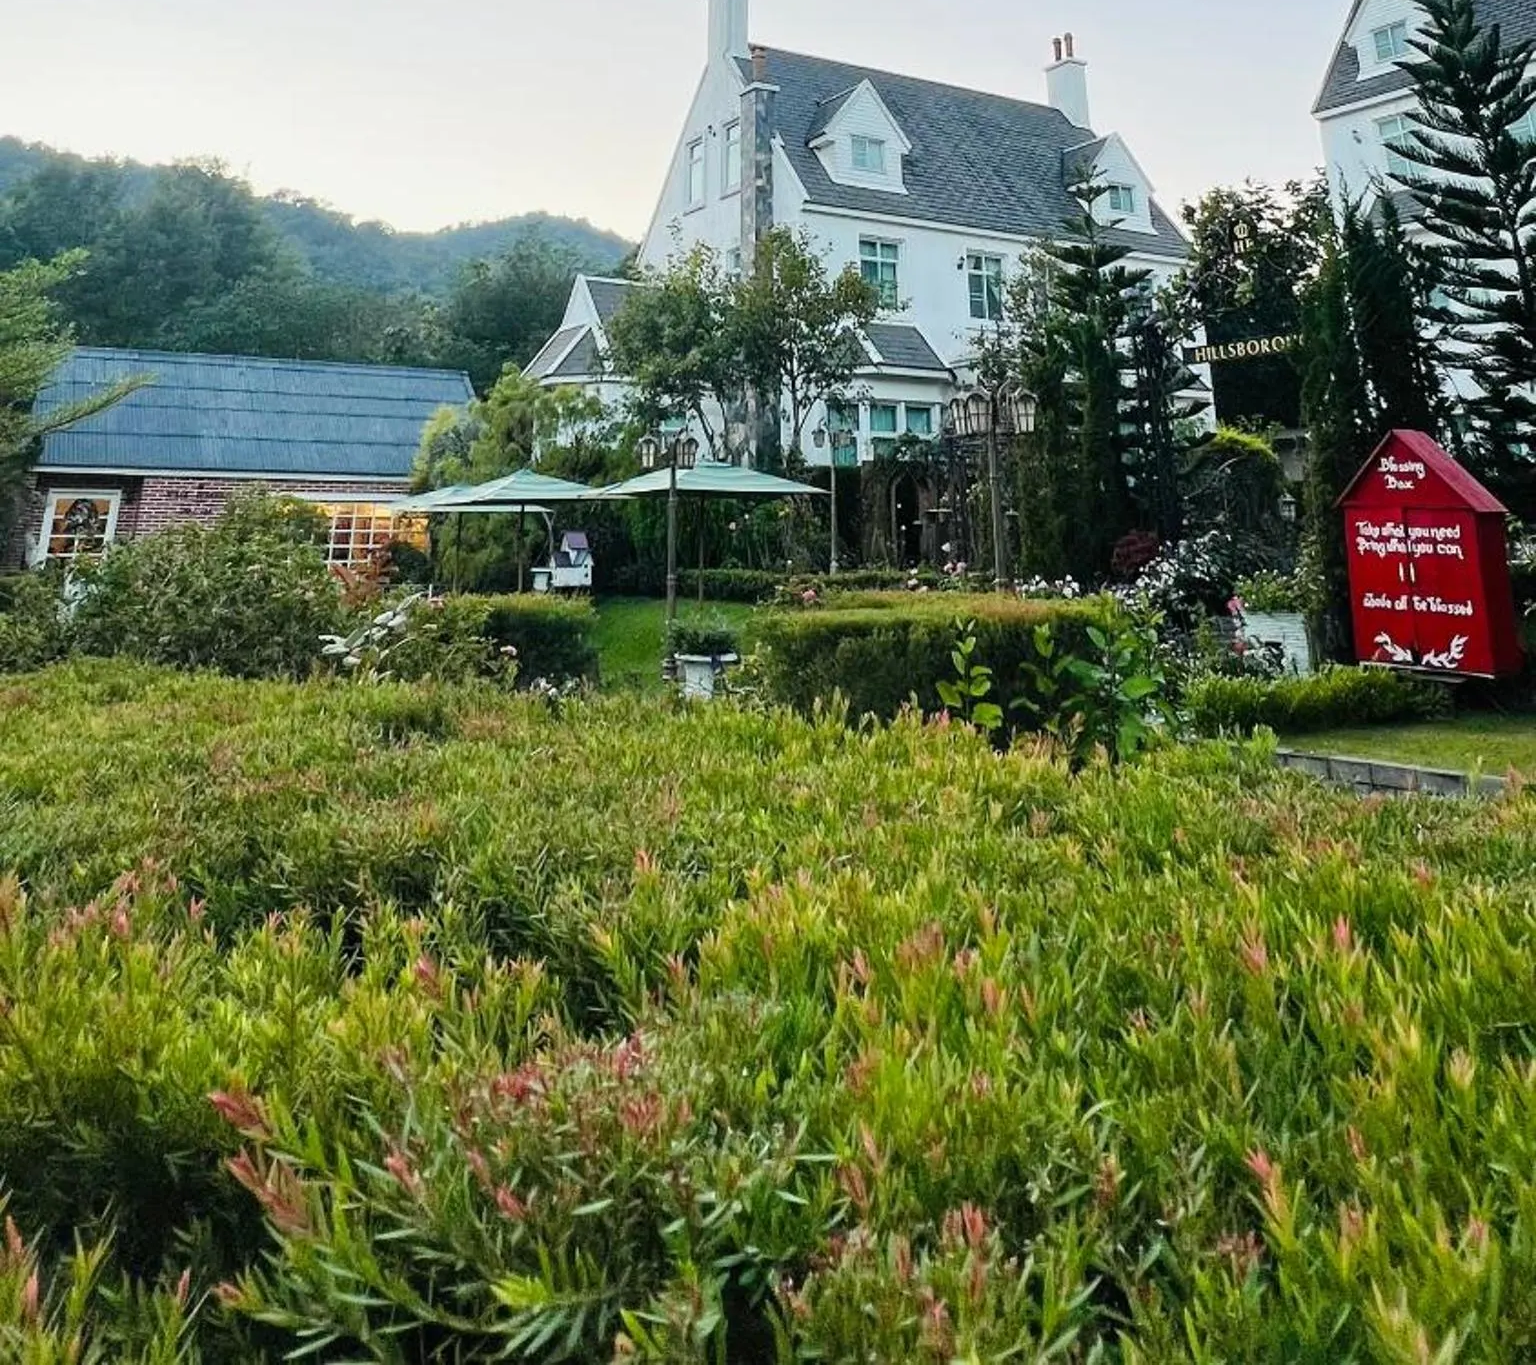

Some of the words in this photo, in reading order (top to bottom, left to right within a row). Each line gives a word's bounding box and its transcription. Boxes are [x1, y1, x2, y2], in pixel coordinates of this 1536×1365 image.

[1377, 456, 1426, 479] Blessing
[1408, 526, 1430, 540] you
[1430, 524, 1461, 541] need
[1413, 542, 1434, 557] you
